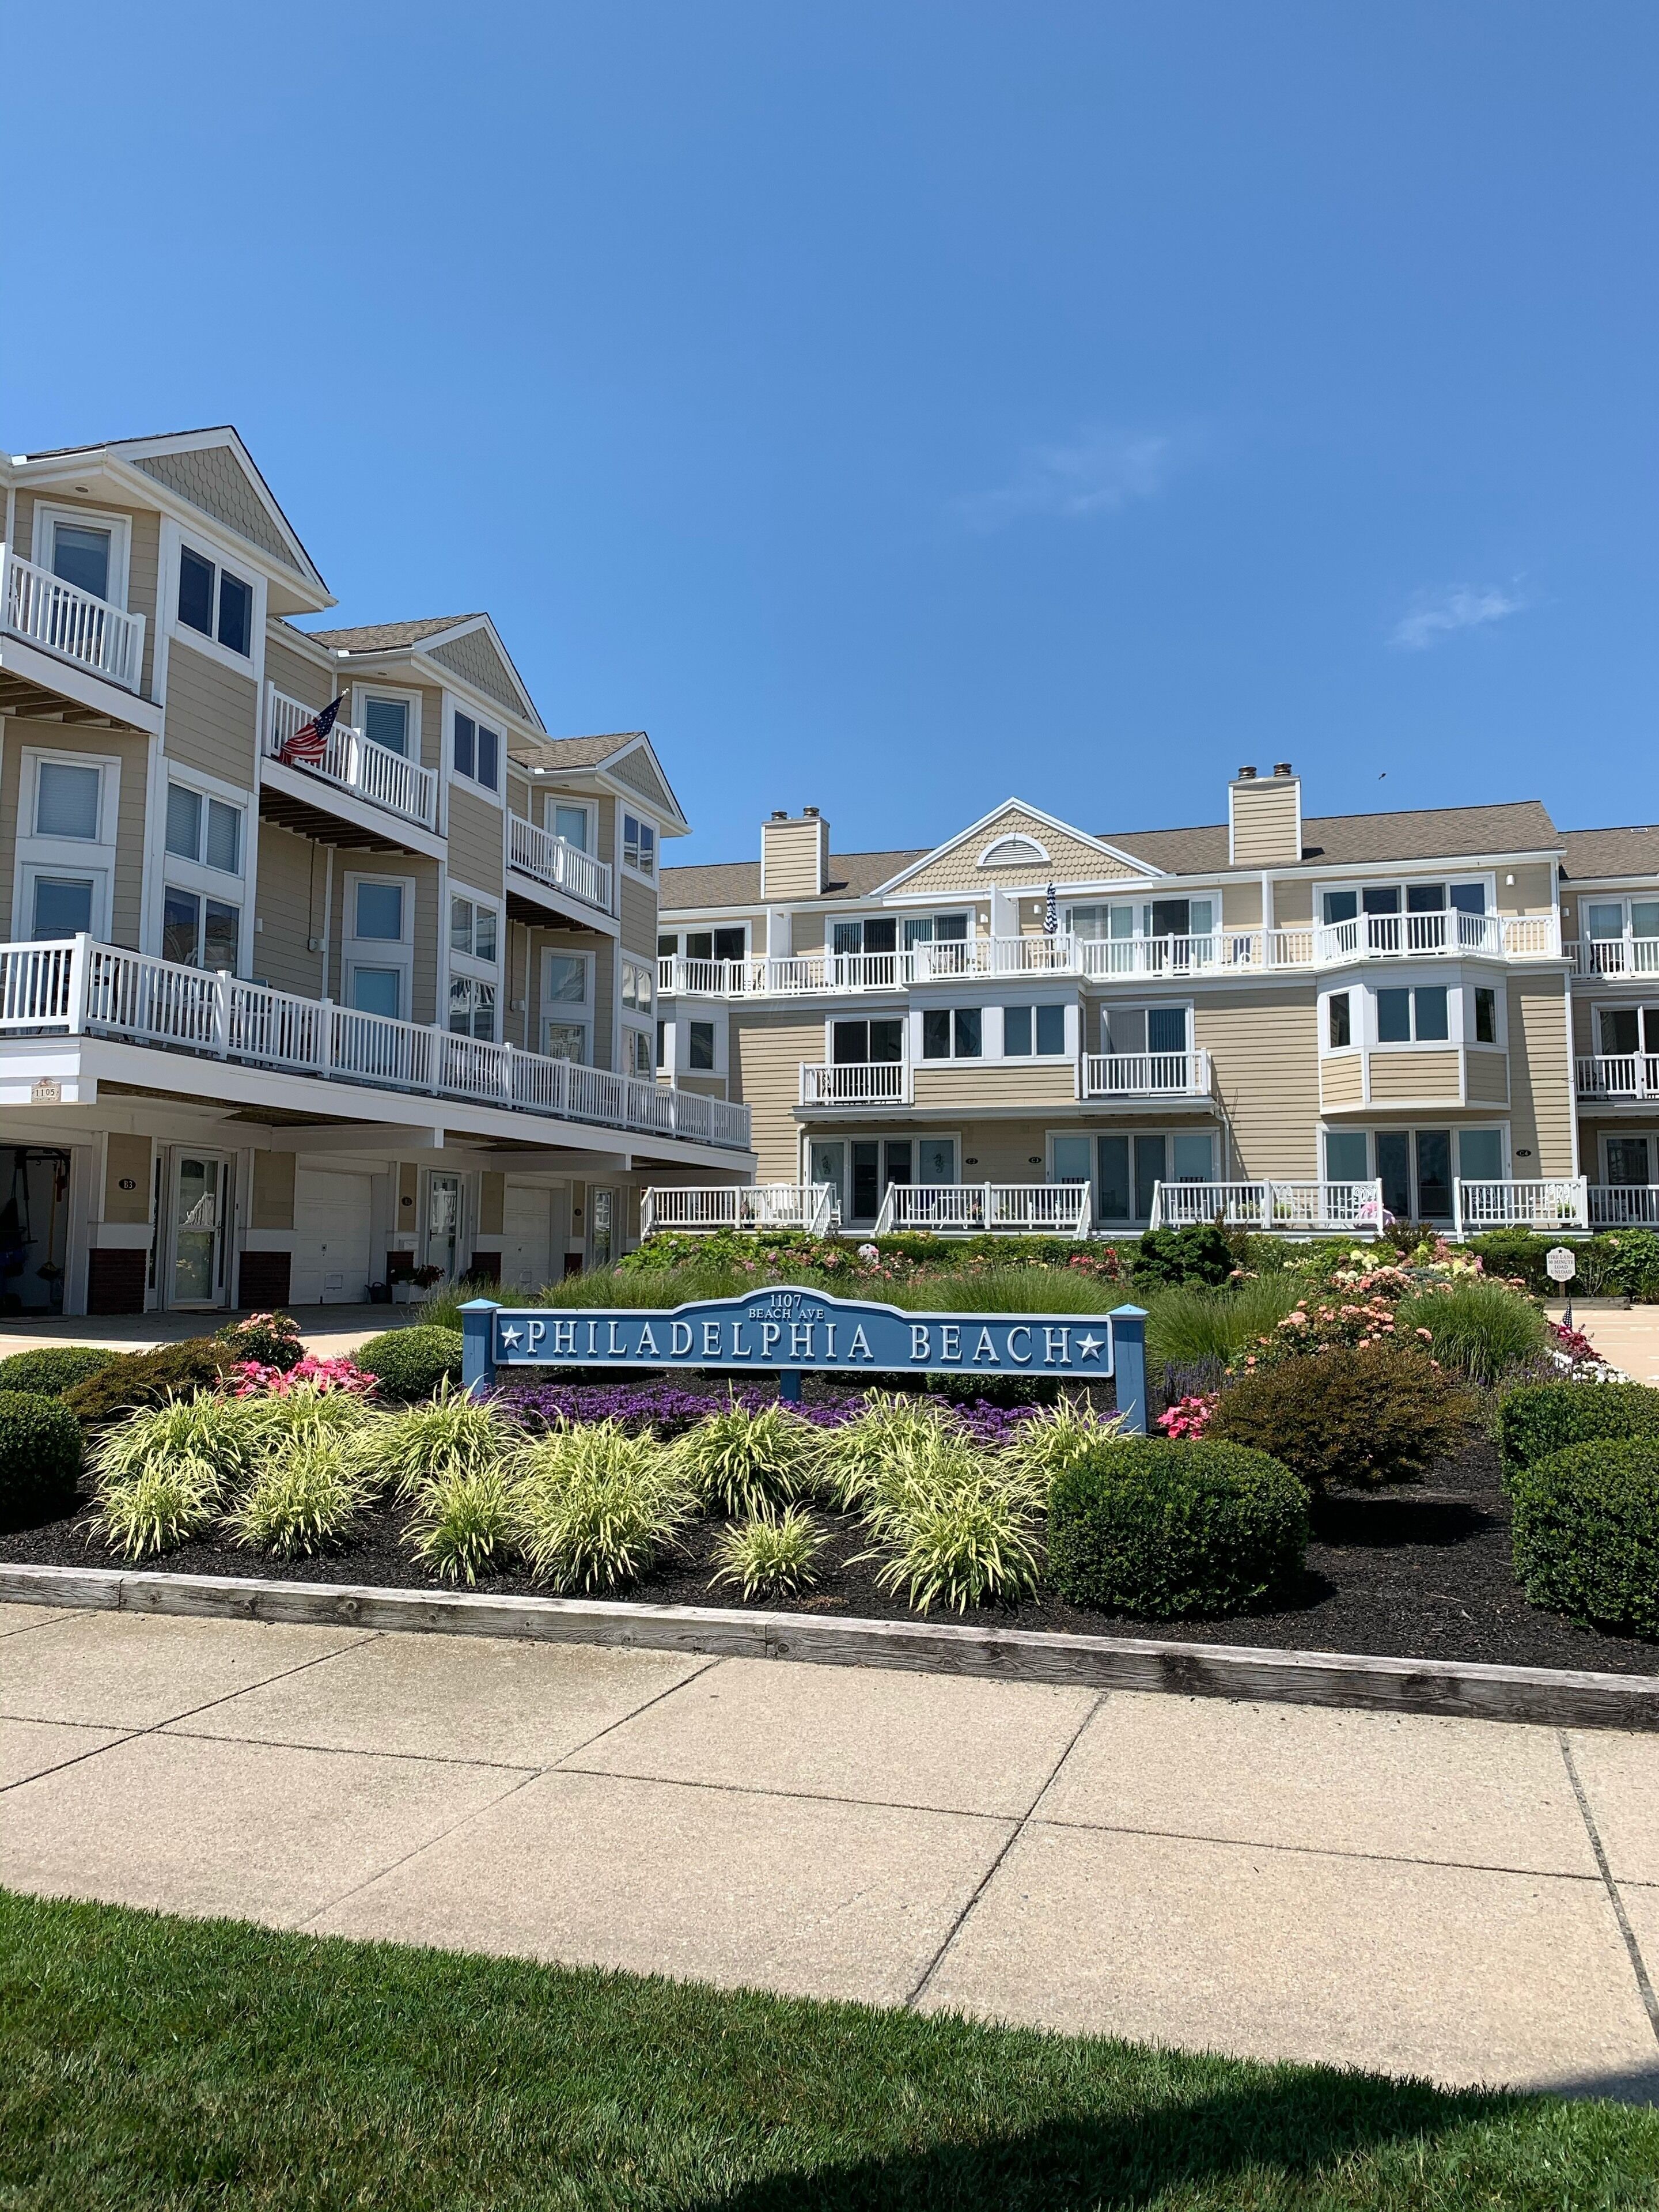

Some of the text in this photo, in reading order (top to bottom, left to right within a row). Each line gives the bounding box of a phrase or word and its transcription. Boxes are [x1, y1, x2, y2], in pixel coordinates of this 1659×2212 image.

[124, 1180, 132, 1188] B3
[770, 1294, 801, 1308] 1107
[749, 1308, 824, 1319] BEACH AVE
[527, 1320, 1072, 1363] PHILADELPHIA BEACH
